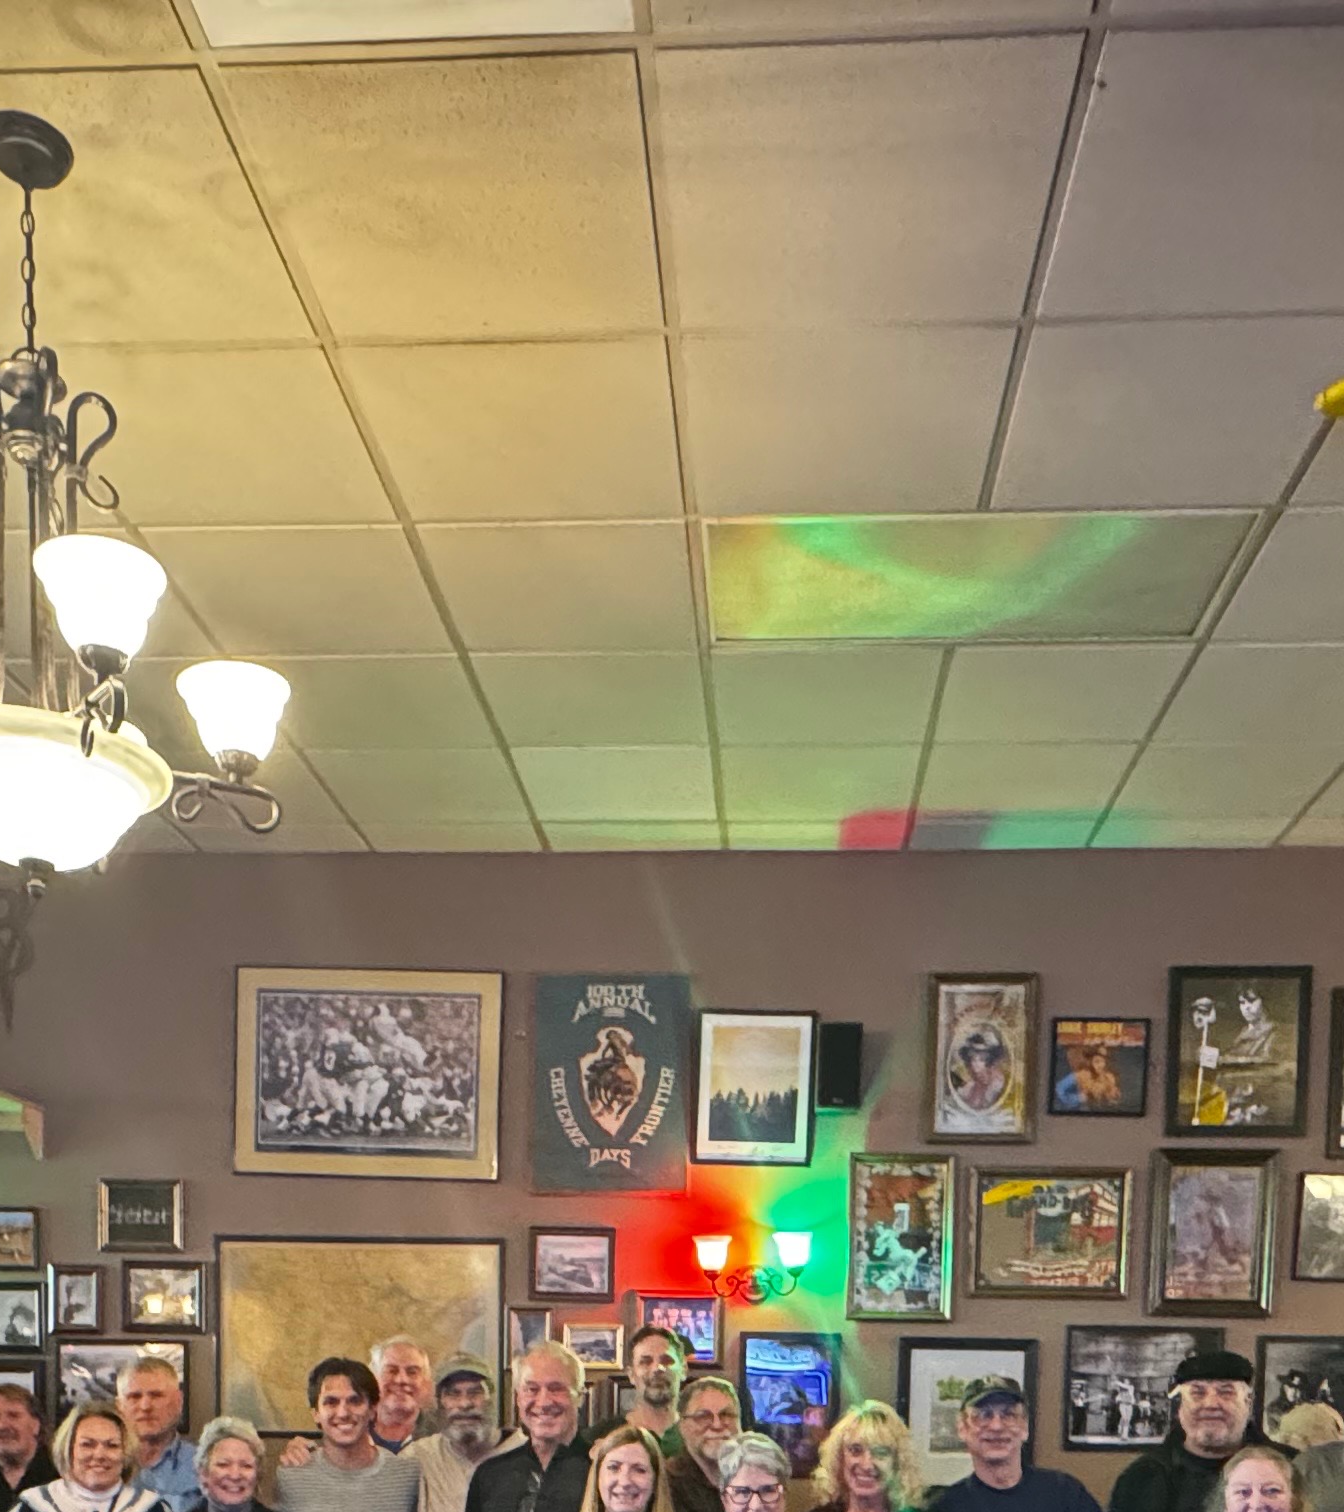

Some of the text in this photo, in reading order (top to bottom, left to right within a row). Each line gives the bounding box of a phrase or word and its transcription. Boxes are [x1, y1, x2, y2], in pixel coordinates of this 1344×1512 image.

[570, 997, 656, 1025] ANNUAL
[550, 1066, 591, 1148] CHEYENNE
[629, 1066, 675, 1147] FRONTIER
[588, 1147, 632, 1169] DAYS
